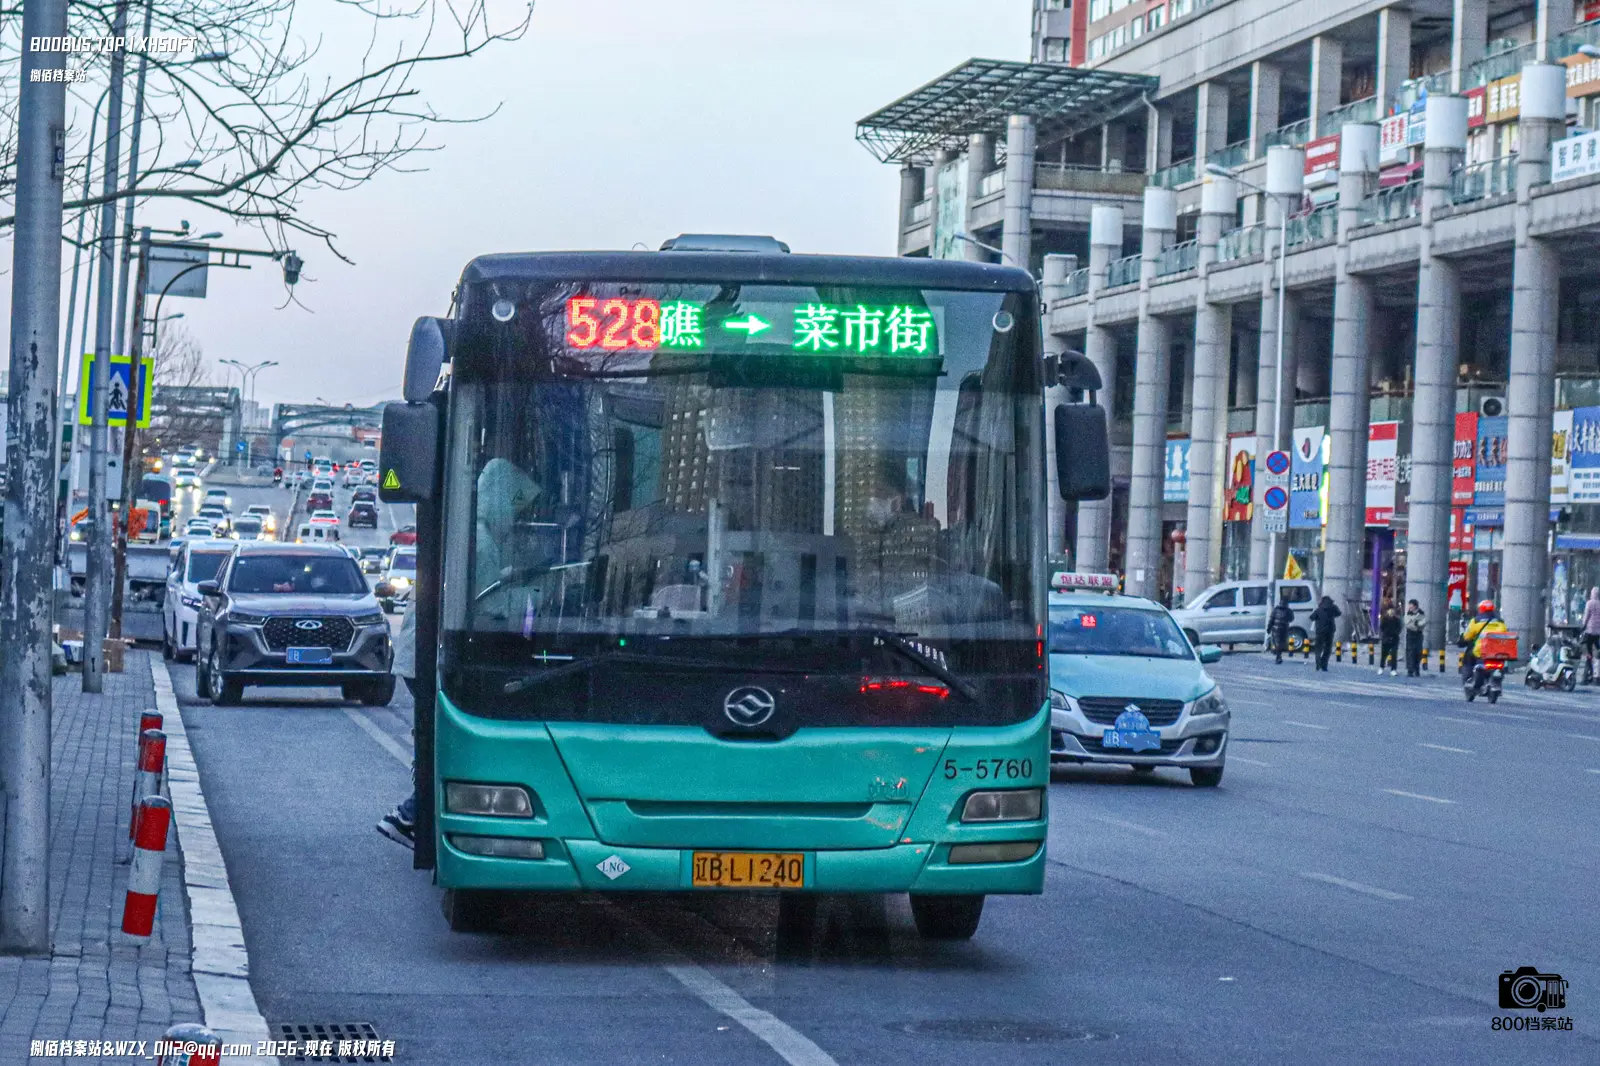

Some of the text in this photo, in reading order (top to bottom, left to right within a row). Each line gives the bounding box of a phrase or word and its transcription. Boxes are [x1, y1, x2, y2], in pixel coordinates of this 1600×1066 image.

[568, 298, 932, 353] 528 礁 菜市街
[944, 759, 1033, 780] 5-5760
[602, 861, 625, 873] LNG
